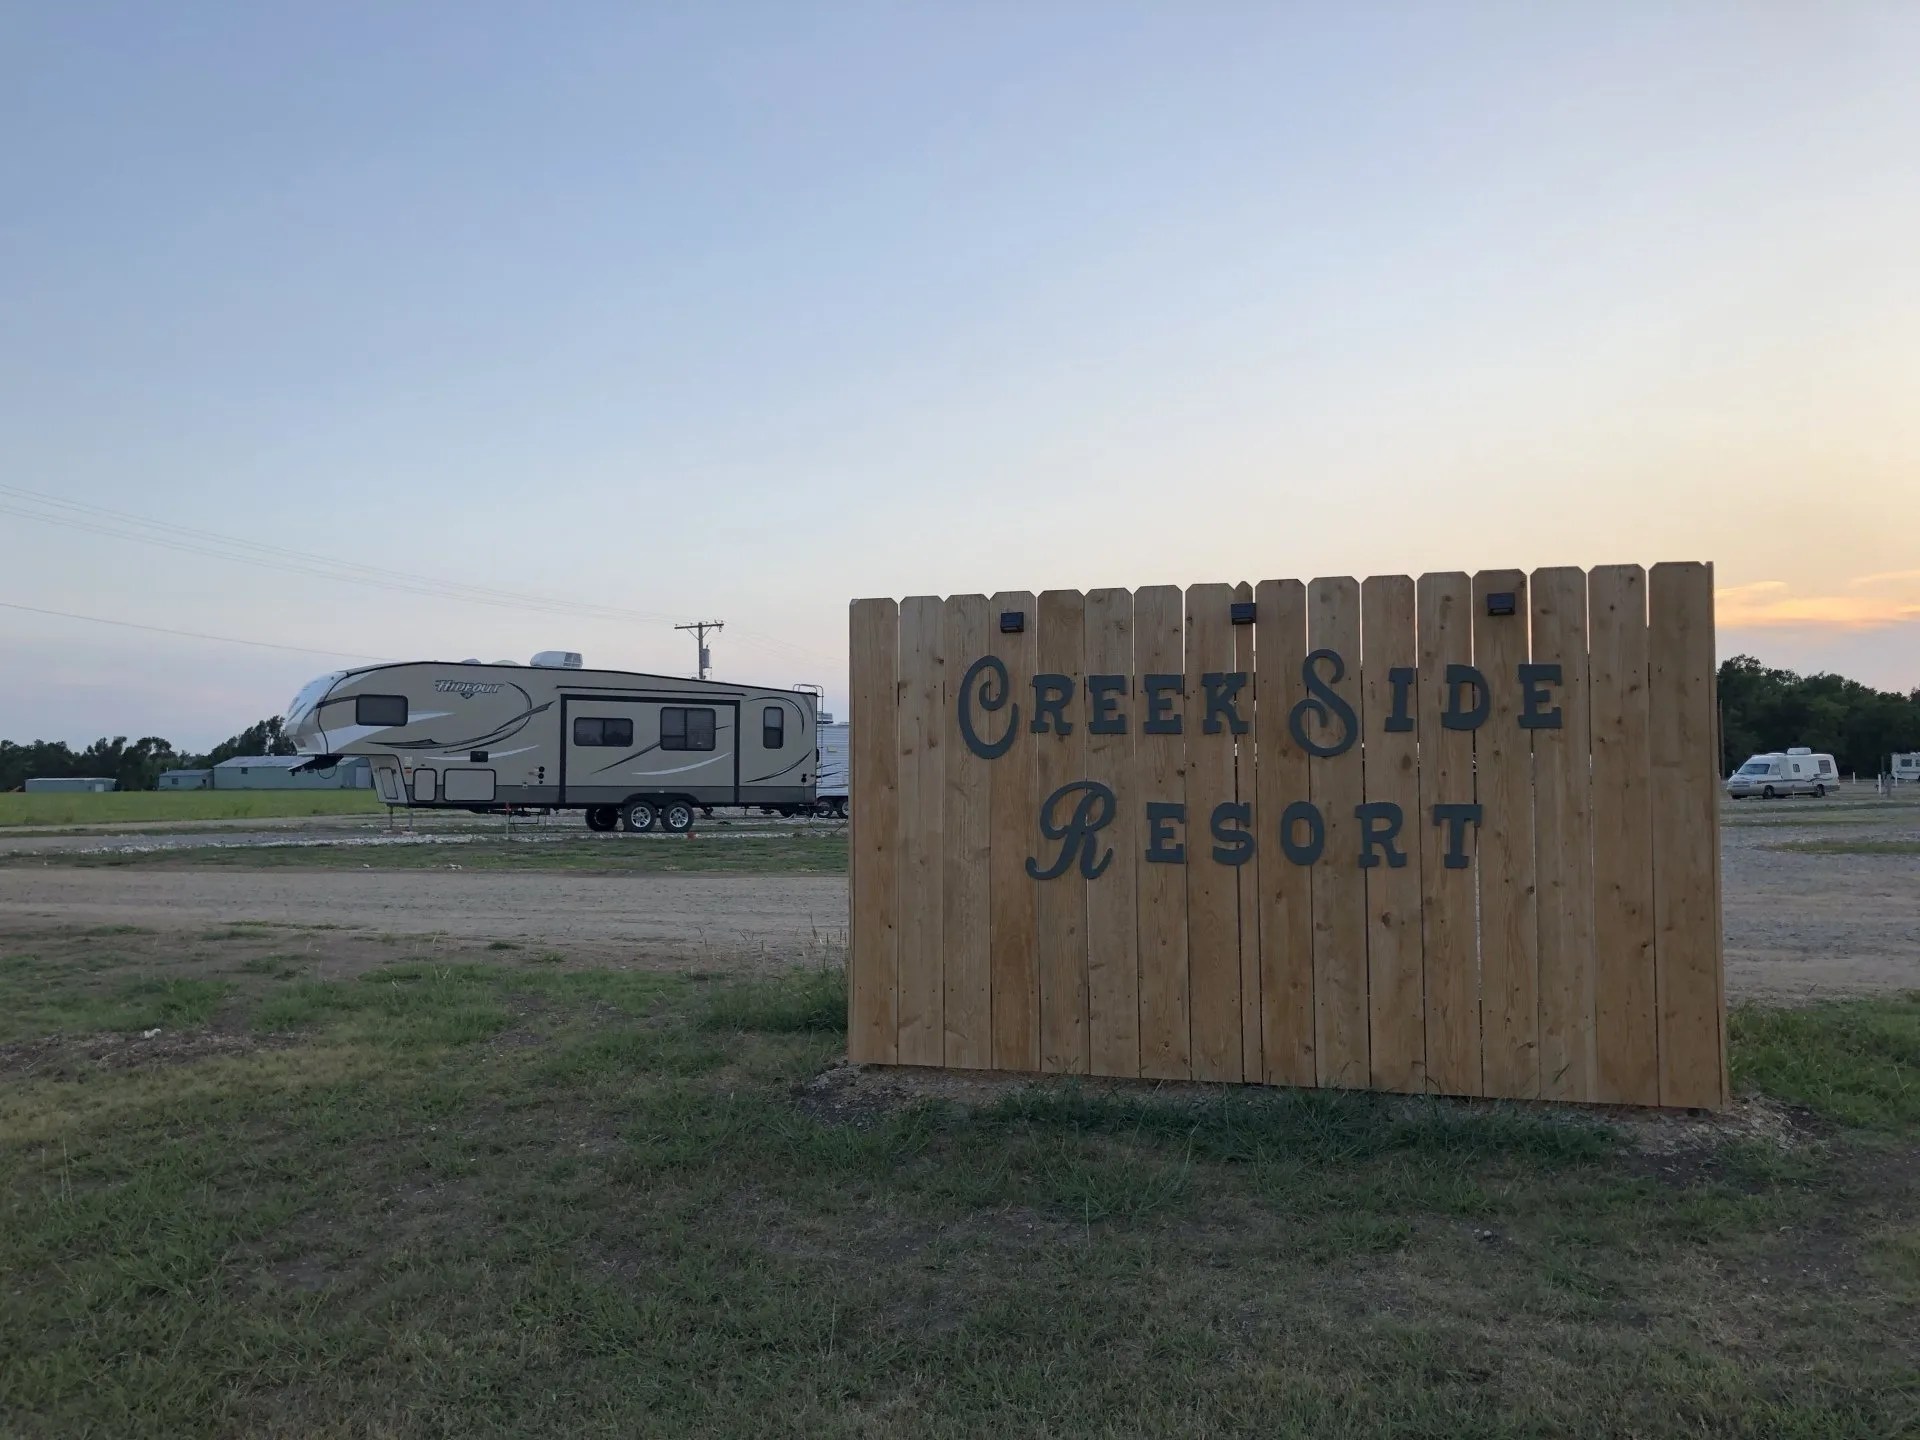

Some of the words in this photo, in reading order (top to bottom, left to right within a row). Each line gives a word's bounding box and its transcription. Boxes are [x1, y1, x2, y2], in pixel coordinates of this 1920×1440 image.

[436, 679, 505, 694] HIDEOUT
[958, 655, 1249, 759] CREEK
[1289, 649, 1562, 757] SIDE
[1025, 780, 1482, 880] RESORT
